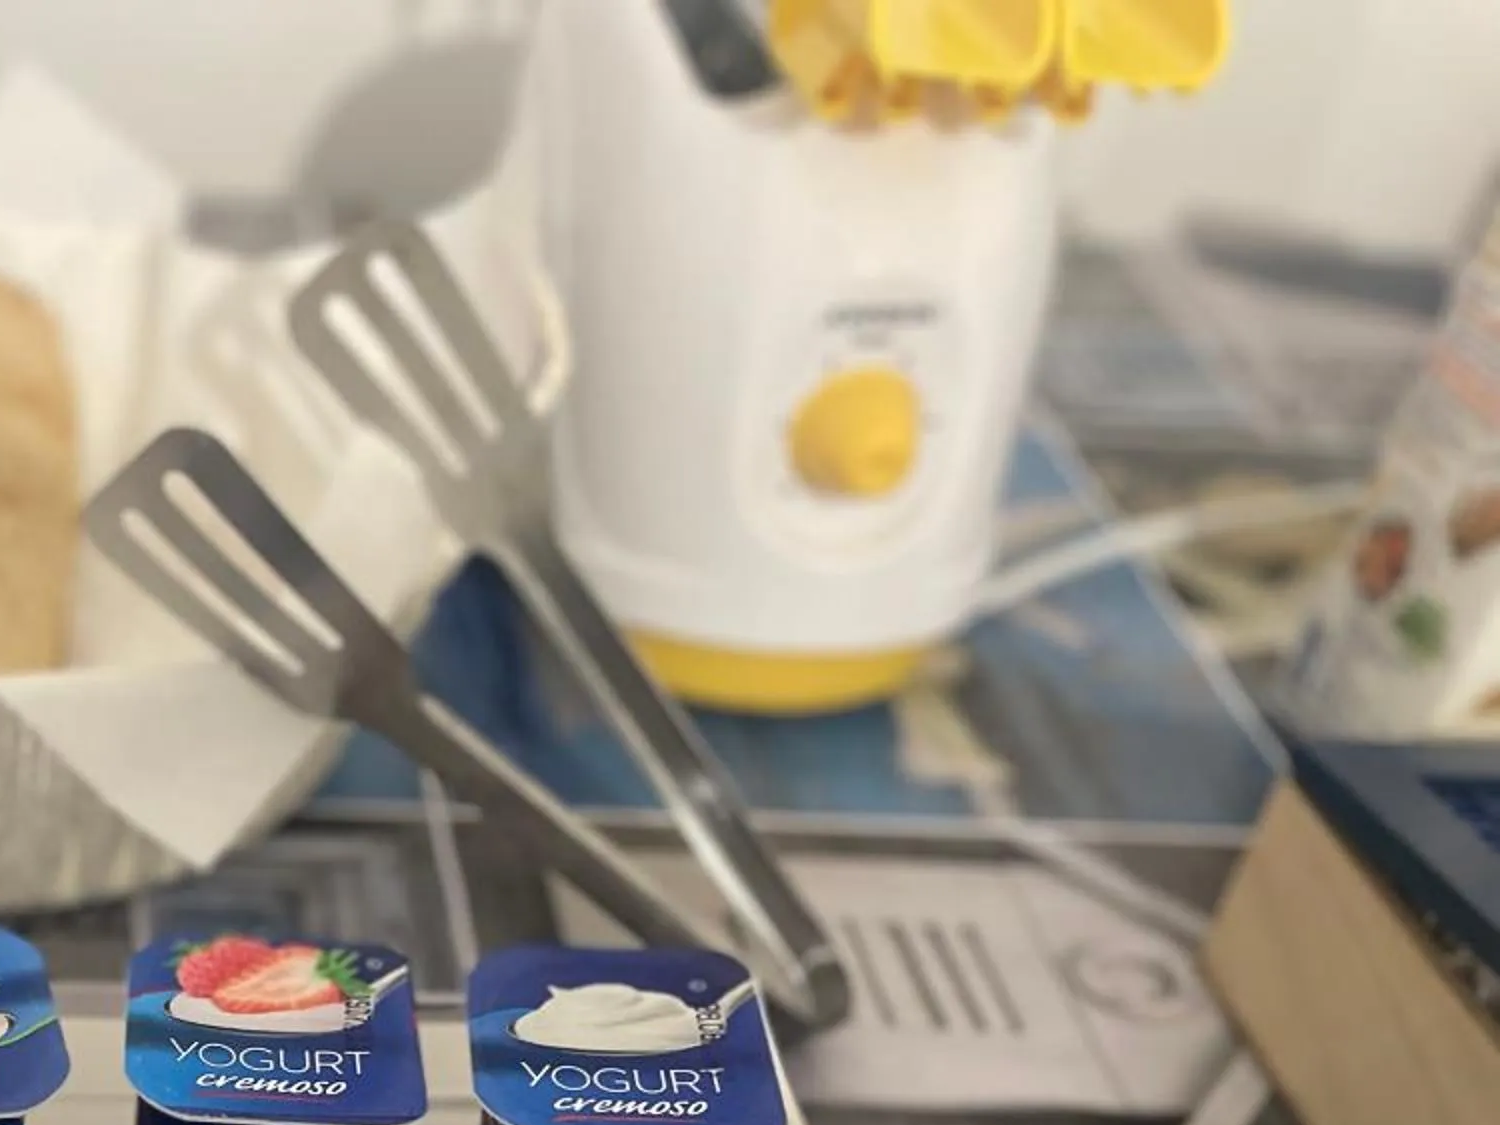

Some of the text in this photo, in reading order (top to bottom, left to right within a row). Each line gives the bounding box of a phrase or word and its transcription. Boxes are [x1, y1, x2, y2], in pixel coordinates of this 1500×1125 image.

[169, 1037, 371, 1075] YOGURT
[196, 1072, 347, 1096] cremoso
[520, 1061, 724, 1094] YOGURT
[553, 1096, 708, 1116] cremoso
